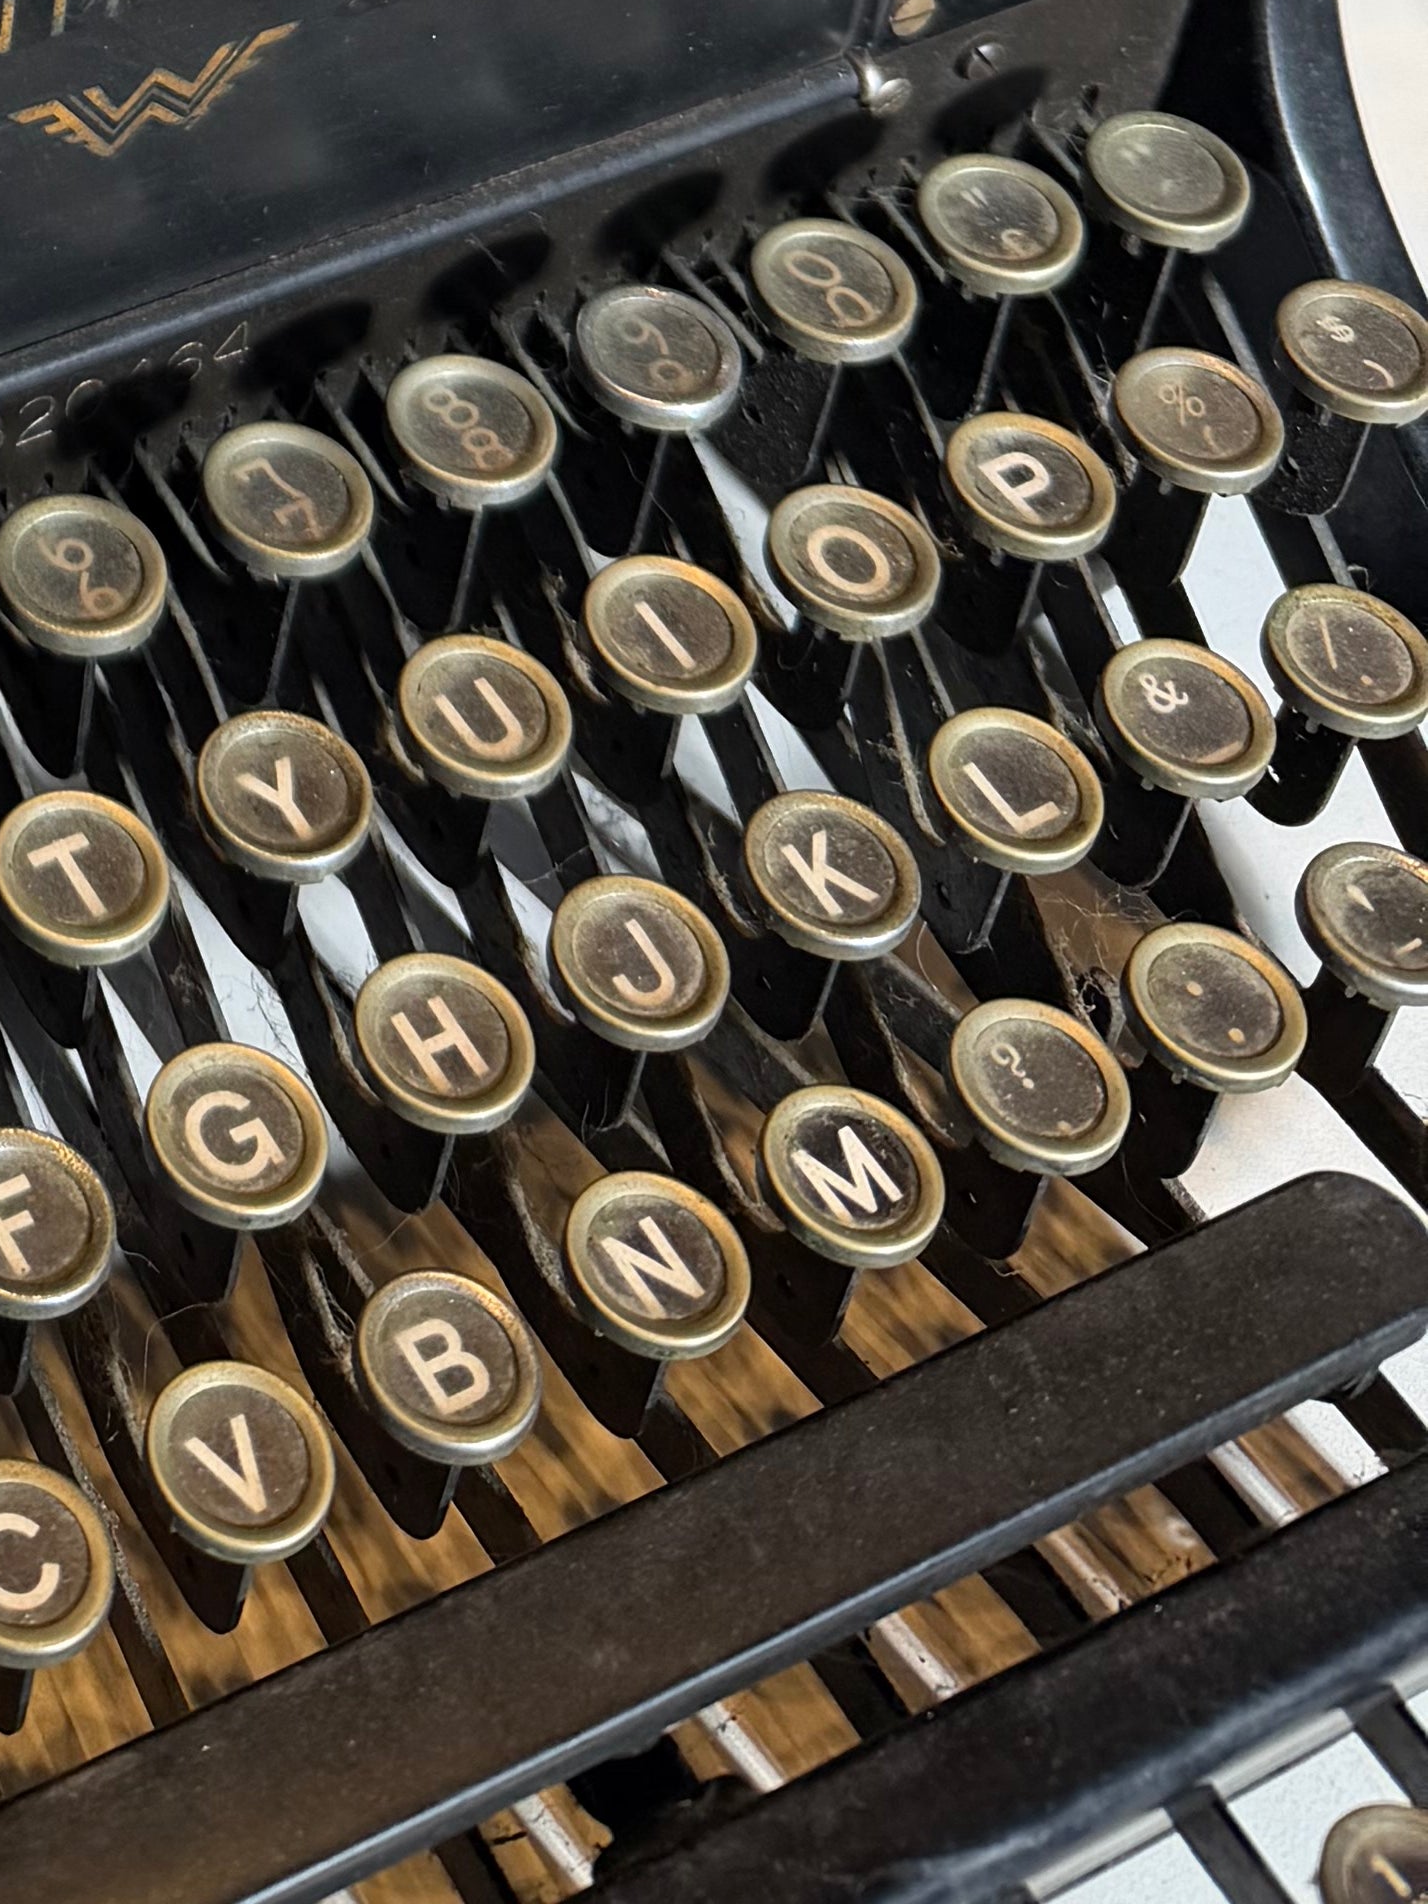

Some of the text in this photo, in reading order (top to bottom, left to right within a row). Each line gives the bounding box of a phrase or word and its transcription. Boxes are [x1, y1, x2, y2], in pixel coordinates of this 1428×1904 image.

[425, 388, 480, 431] 8
[978, 450, 1052, 526] P
[806, 523, 892, 595] O
[633, 599, 698, 671] I
[432, 676, 526, 759] U
[1138, 672, 1190, 714] &
[236, 755, 315, 839] Y
[962, 761, 1062, 837] L
[26, 831, 108, 920] T
[780, 828, 881, 918] K
[611, 917, 675, 1009] J
[390, 994, 490, 1089] H
[990, 1042, 1036, 1090] ?
[183, 1090, 286, 1183] G
[789, 1124, 905, 1225] M
[599, 1214, 706, 1320] N
[394, 1316, 493, 1417] B
[184, 1412, 268, 1515] V
